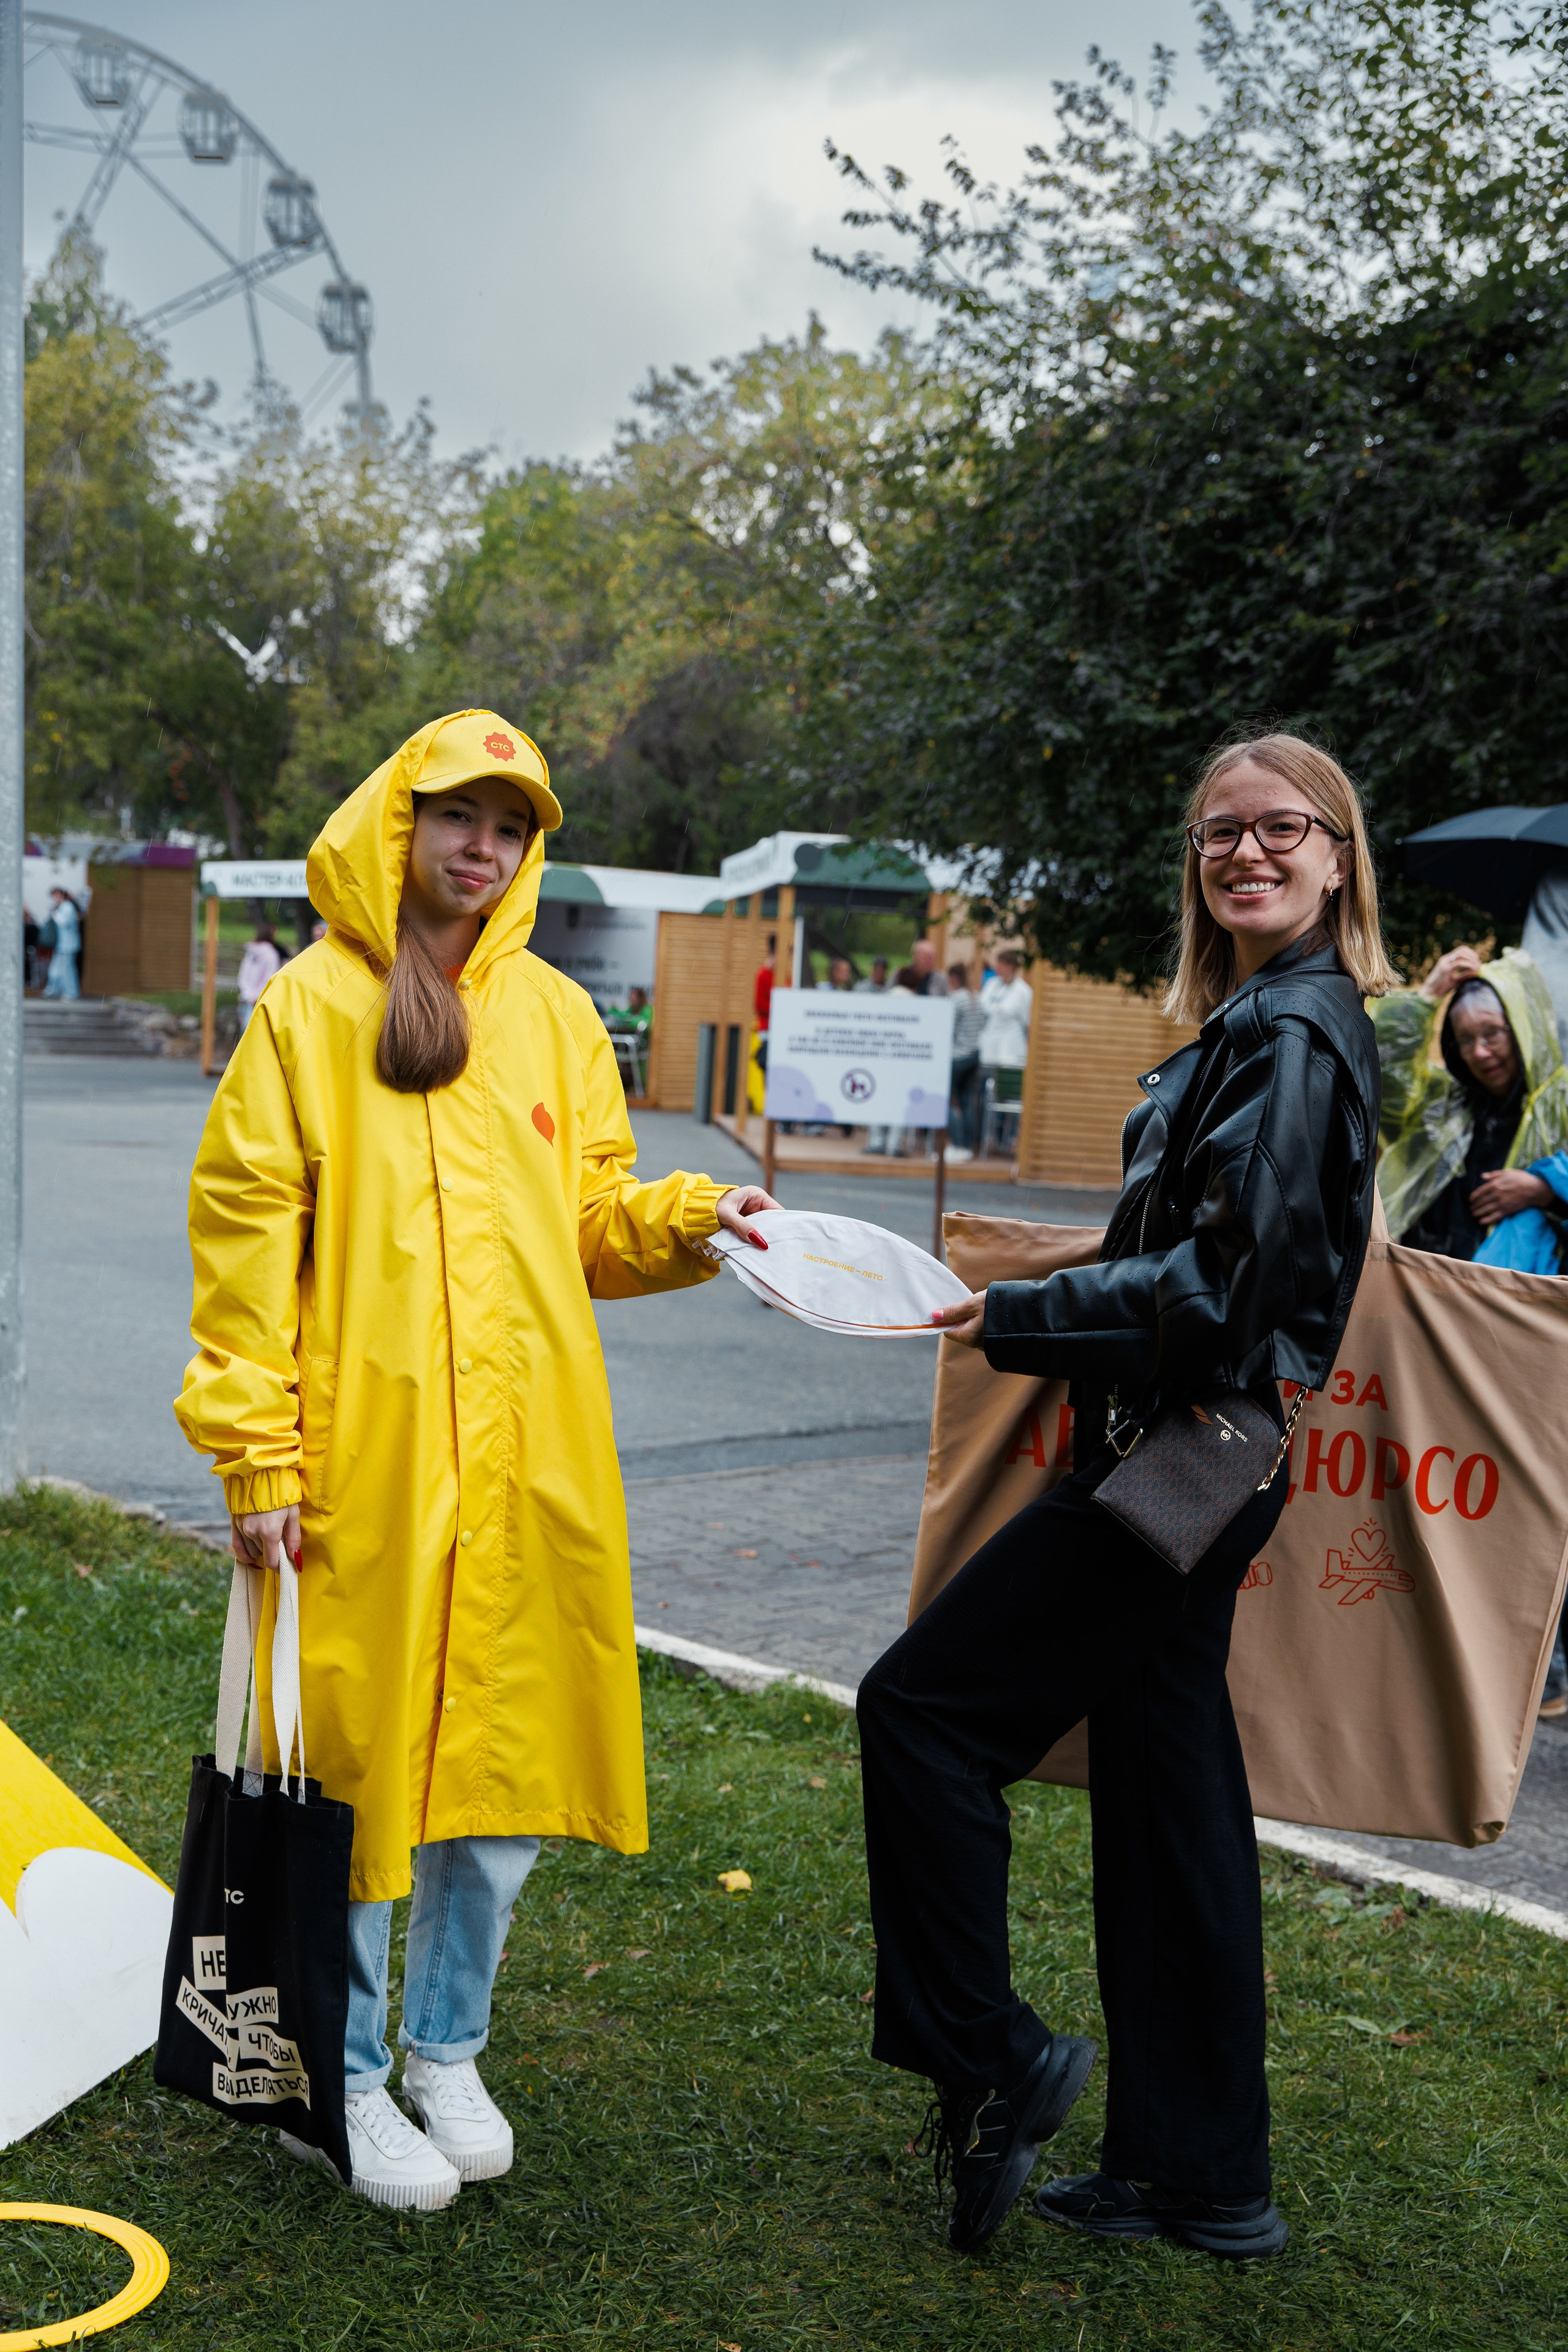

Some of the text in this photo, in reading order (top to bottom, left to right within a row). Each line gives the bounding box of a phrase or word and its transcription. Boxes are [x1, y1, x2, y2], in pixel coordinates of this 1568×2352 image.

[490, 741, 511, 752] СТС
[802, 1253, 855, 1273] НАСТРОЕНИЕ
[861, 1270, 883, 1281] ЛЕТО
[1330, 1370, 1389, 1412] ЗА
[1216, 1413, 1248, 1442] MICHAEL KORS
[1286, 1428, 1500, 1520] ЮРСО
[224, 1888, 245, 1905] ТС
[201, 1950, 226, 1977] НЕ
[227, 1996, 276, 2021] УЖНО
[247, 2032, 296, 2063] ЧТОБЫ
